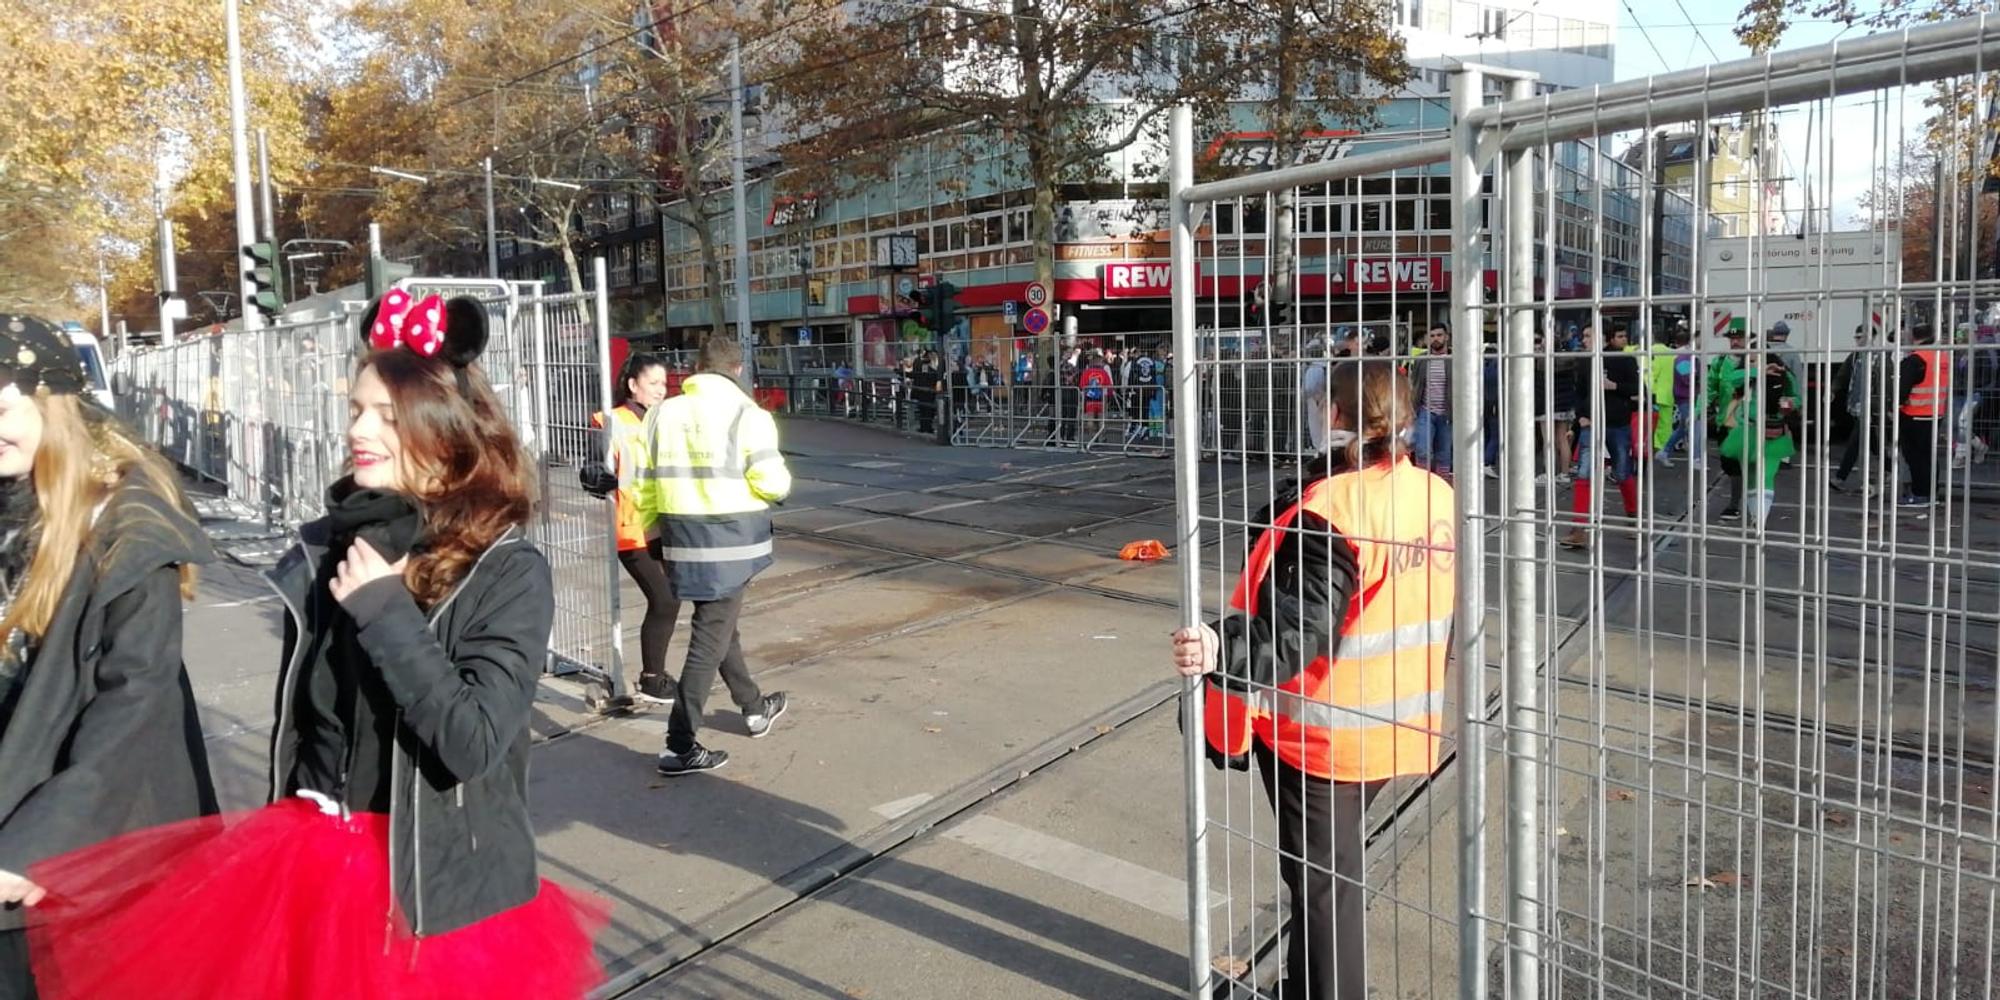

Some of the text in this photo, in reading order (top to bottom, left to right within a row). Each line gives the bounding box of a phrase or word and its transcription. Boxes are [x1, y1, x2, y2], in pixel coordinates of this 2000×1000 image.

[1364, 239, 1401, 250] KURSE
[1068, 246, 1114, 257] FITNESS
[1112, 265, 1173, 288] REW
[1353, 261, 1430, 283] REWE
[1031, 289, 1042, 300] 30
